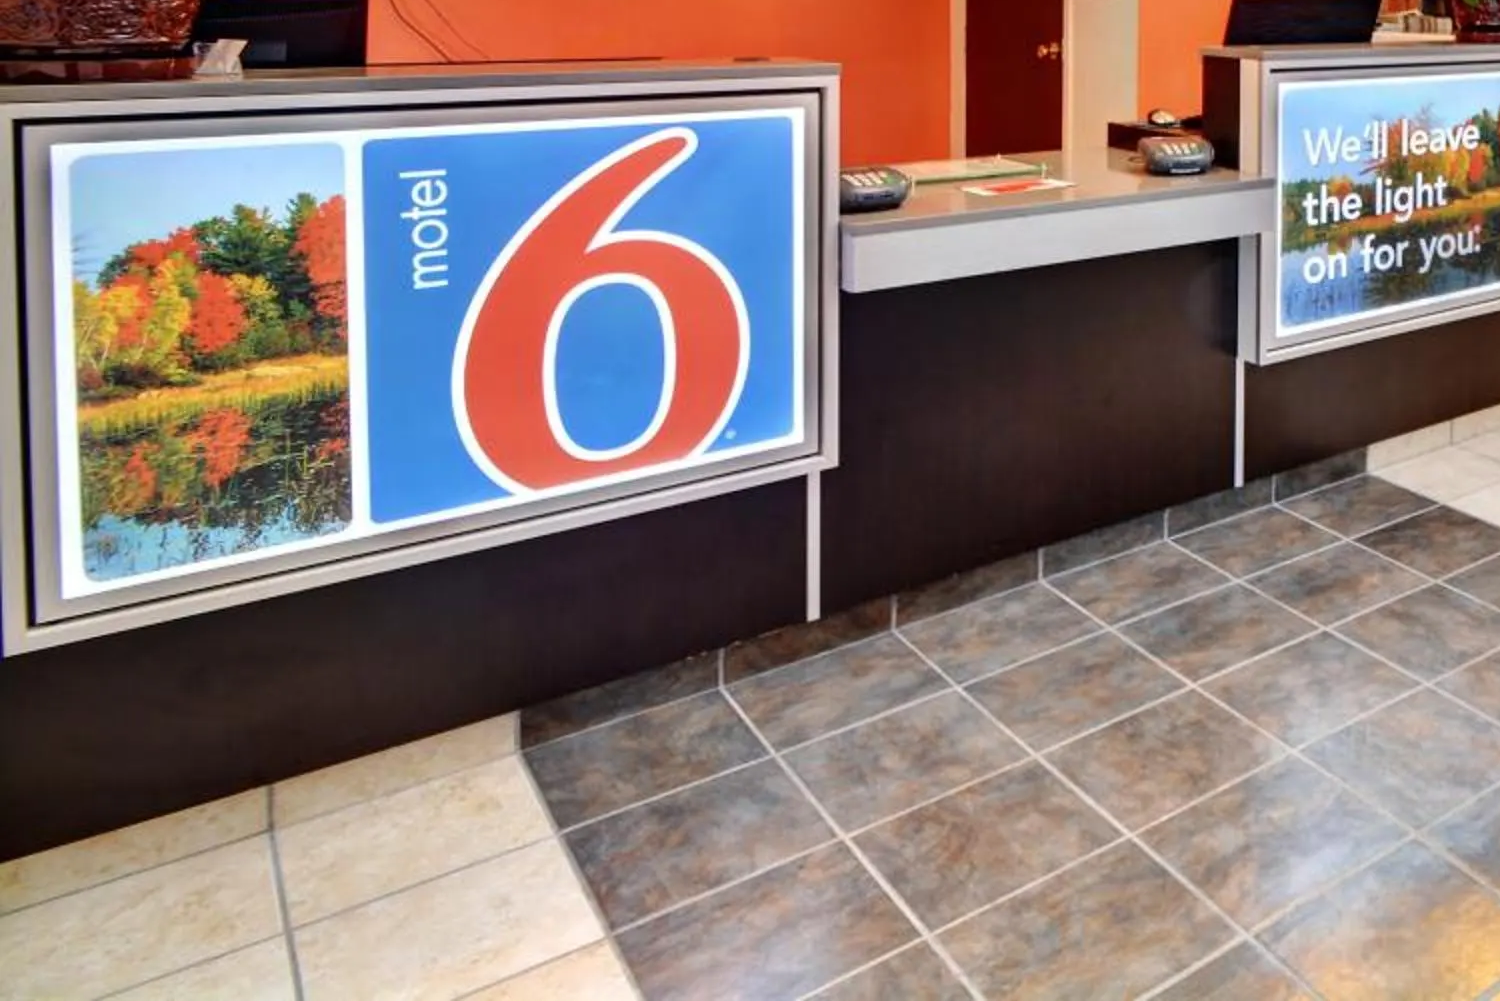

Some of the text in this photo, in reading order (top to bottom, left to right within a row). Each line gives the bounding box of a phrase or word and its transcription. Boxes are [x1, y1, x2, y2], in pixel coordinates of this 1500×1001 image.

[1303, 119, 1480, 166] We'll leave
[1302, 172, 1448, 227] the light
[1303, 251, 1348, 284] on
[1359, 233, 1409, 273] for
[399, 126, 751, 496] motel 6
